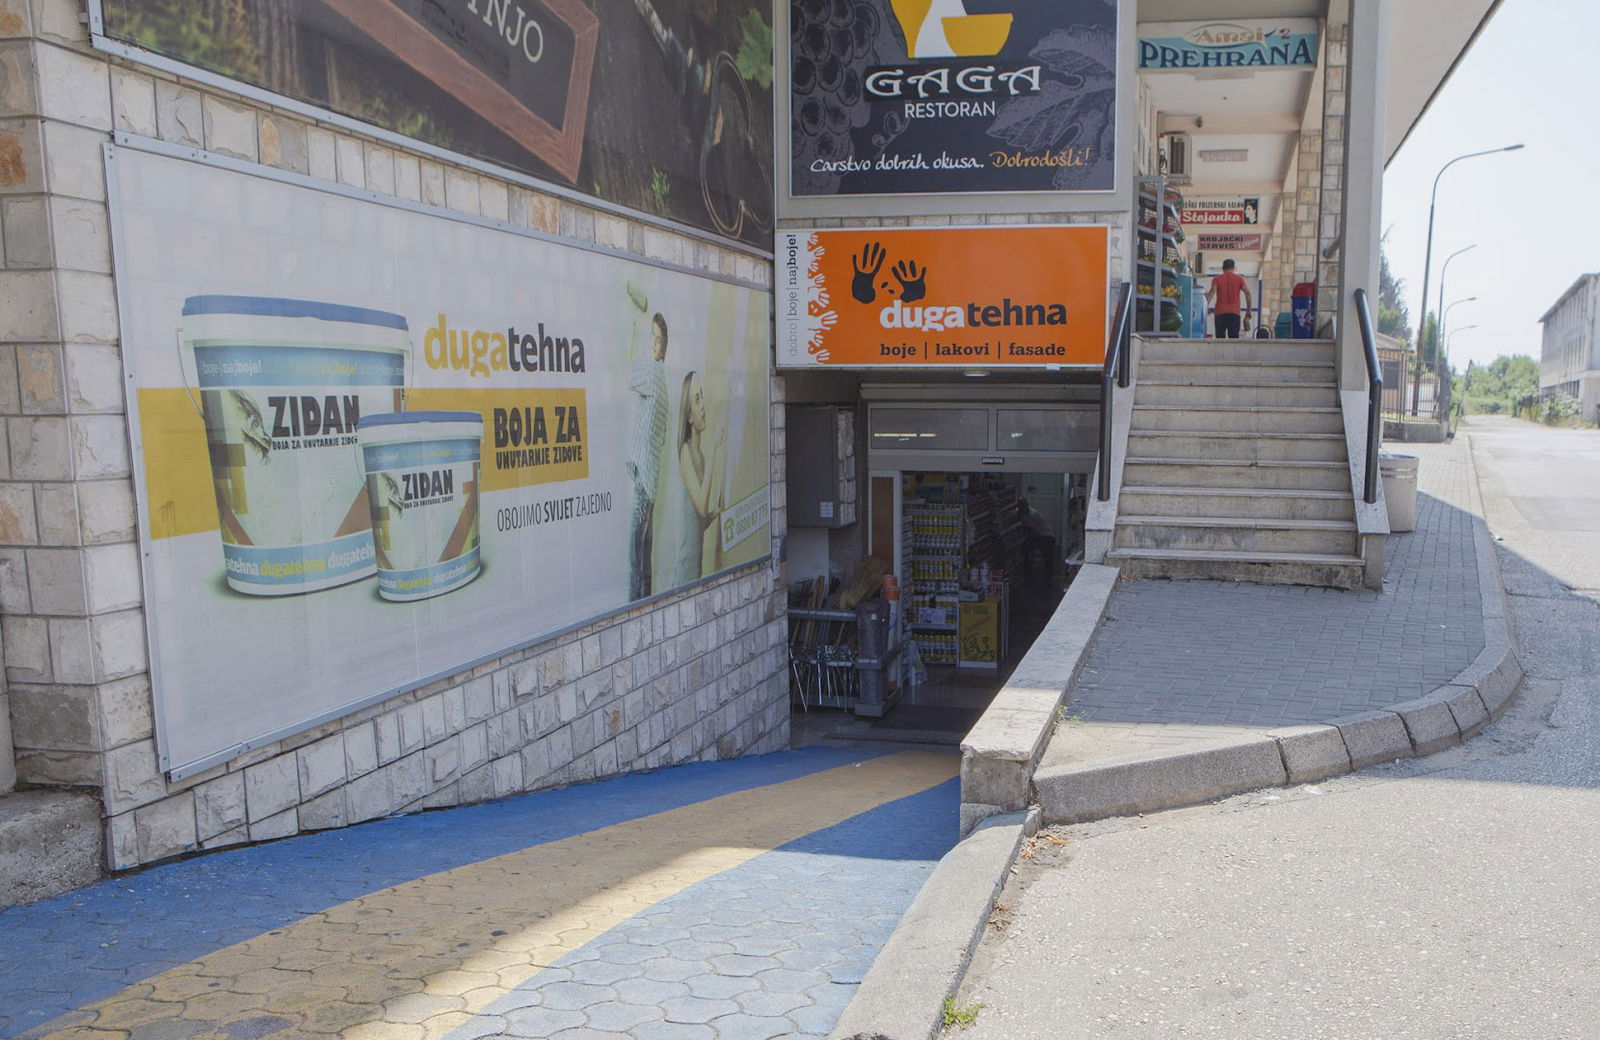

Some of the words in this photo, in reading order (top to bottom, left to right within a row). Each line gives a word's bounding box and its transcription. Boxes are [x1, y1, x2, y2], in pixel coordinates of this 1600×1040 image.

[1139, 38, 1313, 68] PREHRANA
[865, 66, 1042, 98] GAGA
[904, 101, 996, 119] RESTORAN
[810, 155, 871, 173] Carstvo
[875, 154, 930, 171] dobrih
[933, 151, 984, 170] okusa.
[989, 148, 1090, 168] Dobrodošli!
[1182, 211, 1241, 224] Stojanka
[786, 234, 799, 285] najboje!
[787, 291, 798, 317] boje
[879, 298, 1067, 332] dugatehna
[423, 313, 586, 378] dugatehna
[787, 323, 798, 357] dobro
[880, 343, 916, 358] boje
[935, 342, 990, 356] lakovi
[1009, 342, 1066, 356] fasade
[268, 395, 360, 438] ZIDAN
[494, 407, 548, 448] BOJA
[555, 406, 581, 443] ZA
[272, 440, 290, 451] BOJA
[291, 440, 302, 449] ZA
[496, 447, 550, 470] UNUTARNJE
[553, 445, 582, 464] ZIDOVE
[402, 469, 454, 501] ZIDAN
[497, 502, 542, 532] OBOJIMO
[544, 498, 574, 523] SVIJET
[576, 491, 612, 517] ZAJEDNO
[225, 558, 260, 576] atehna
[260, 557, 327, 578] dugatehna
